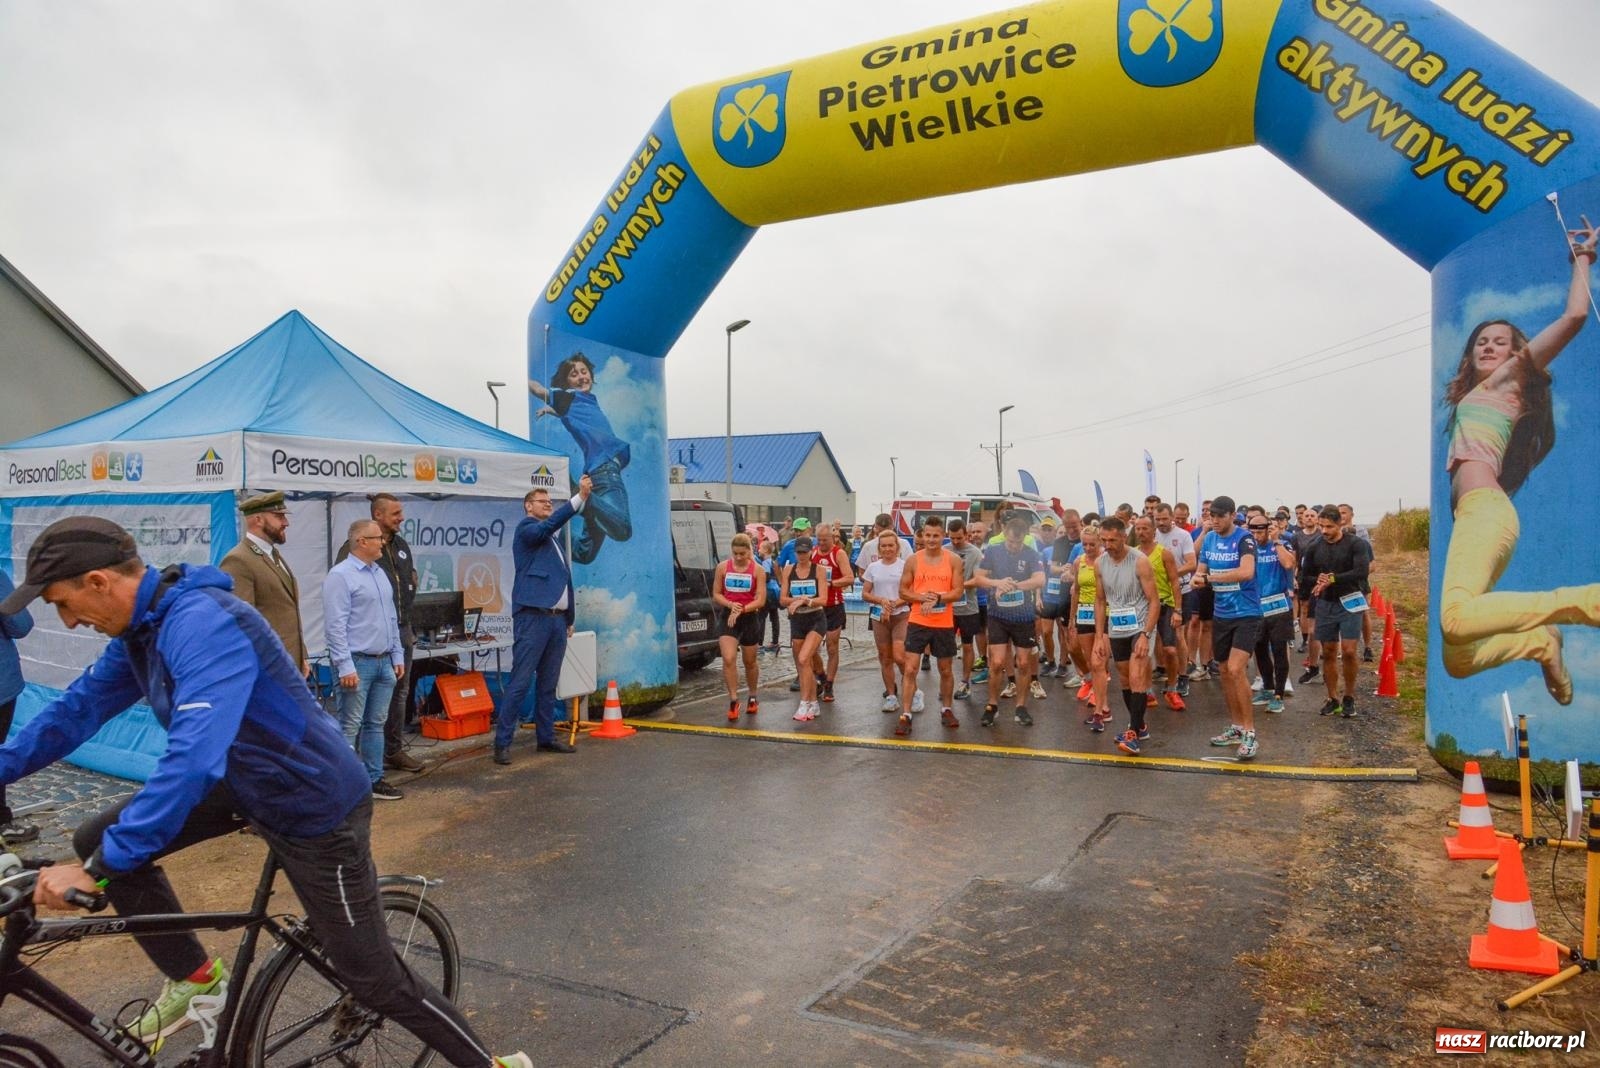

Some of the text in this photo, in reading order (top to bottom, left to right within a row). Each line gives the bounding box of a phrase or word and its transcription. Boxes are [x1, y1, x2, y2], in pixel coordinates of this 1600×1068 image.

[861, 18, 1029, 70] Gmina
[819, 42, 1077, 118] Pietrowice
[1313, 0, 1574, 168] Gmina ludzi
[850, 90, 1044, 151] Wielkie
[1276, 36, 1510, 213] aktywnych
[545, 134, 662, 302] Gmina ludzi
[568, 162, 687, 325] aktywnych
[9, 459, 87, 485] PersonalBest
[196, 461, 224, 476] MITKO
[272, 449, 408, 479] PersonalBest
[530, 475, 555, 487] MITKO
[733, 580, 744, 588] 12
[798, 586, 809, 595] 11
[1084, 610, 1094, 619] 37
[1117, 616, 1129, 626] 15
